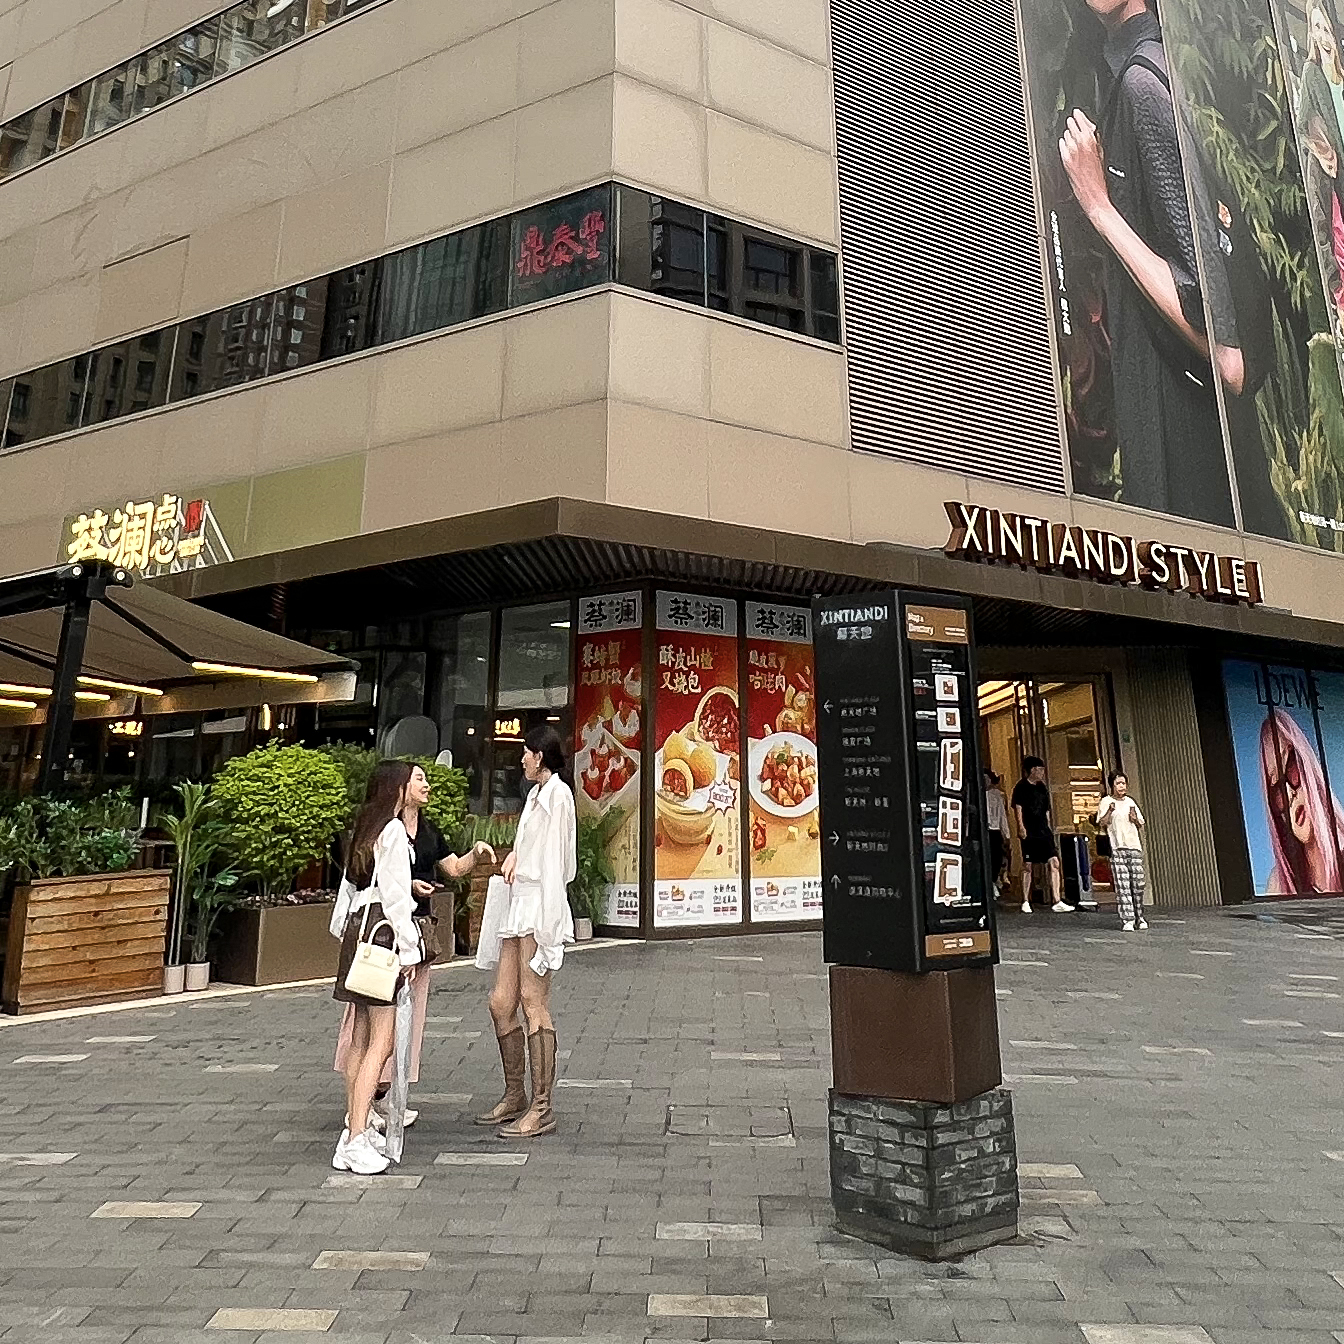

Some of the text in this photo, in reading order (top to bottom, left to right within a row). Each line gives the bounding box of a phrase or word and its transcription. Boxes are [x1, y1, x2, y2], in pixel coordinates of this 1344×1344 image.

[959, 504, 1142, 586] XINTIANDI
[1150, 542, 1251, 599] STYLE
[583, 598, 637, 628] 蔡澜
[667, 597, 725, 630] 蔡澜
[754, 608, 807, 637] 蔡澜
[820, 605, 888, 625] XINTIANDI
[1253, 669, 1325, 712] LOEWE
